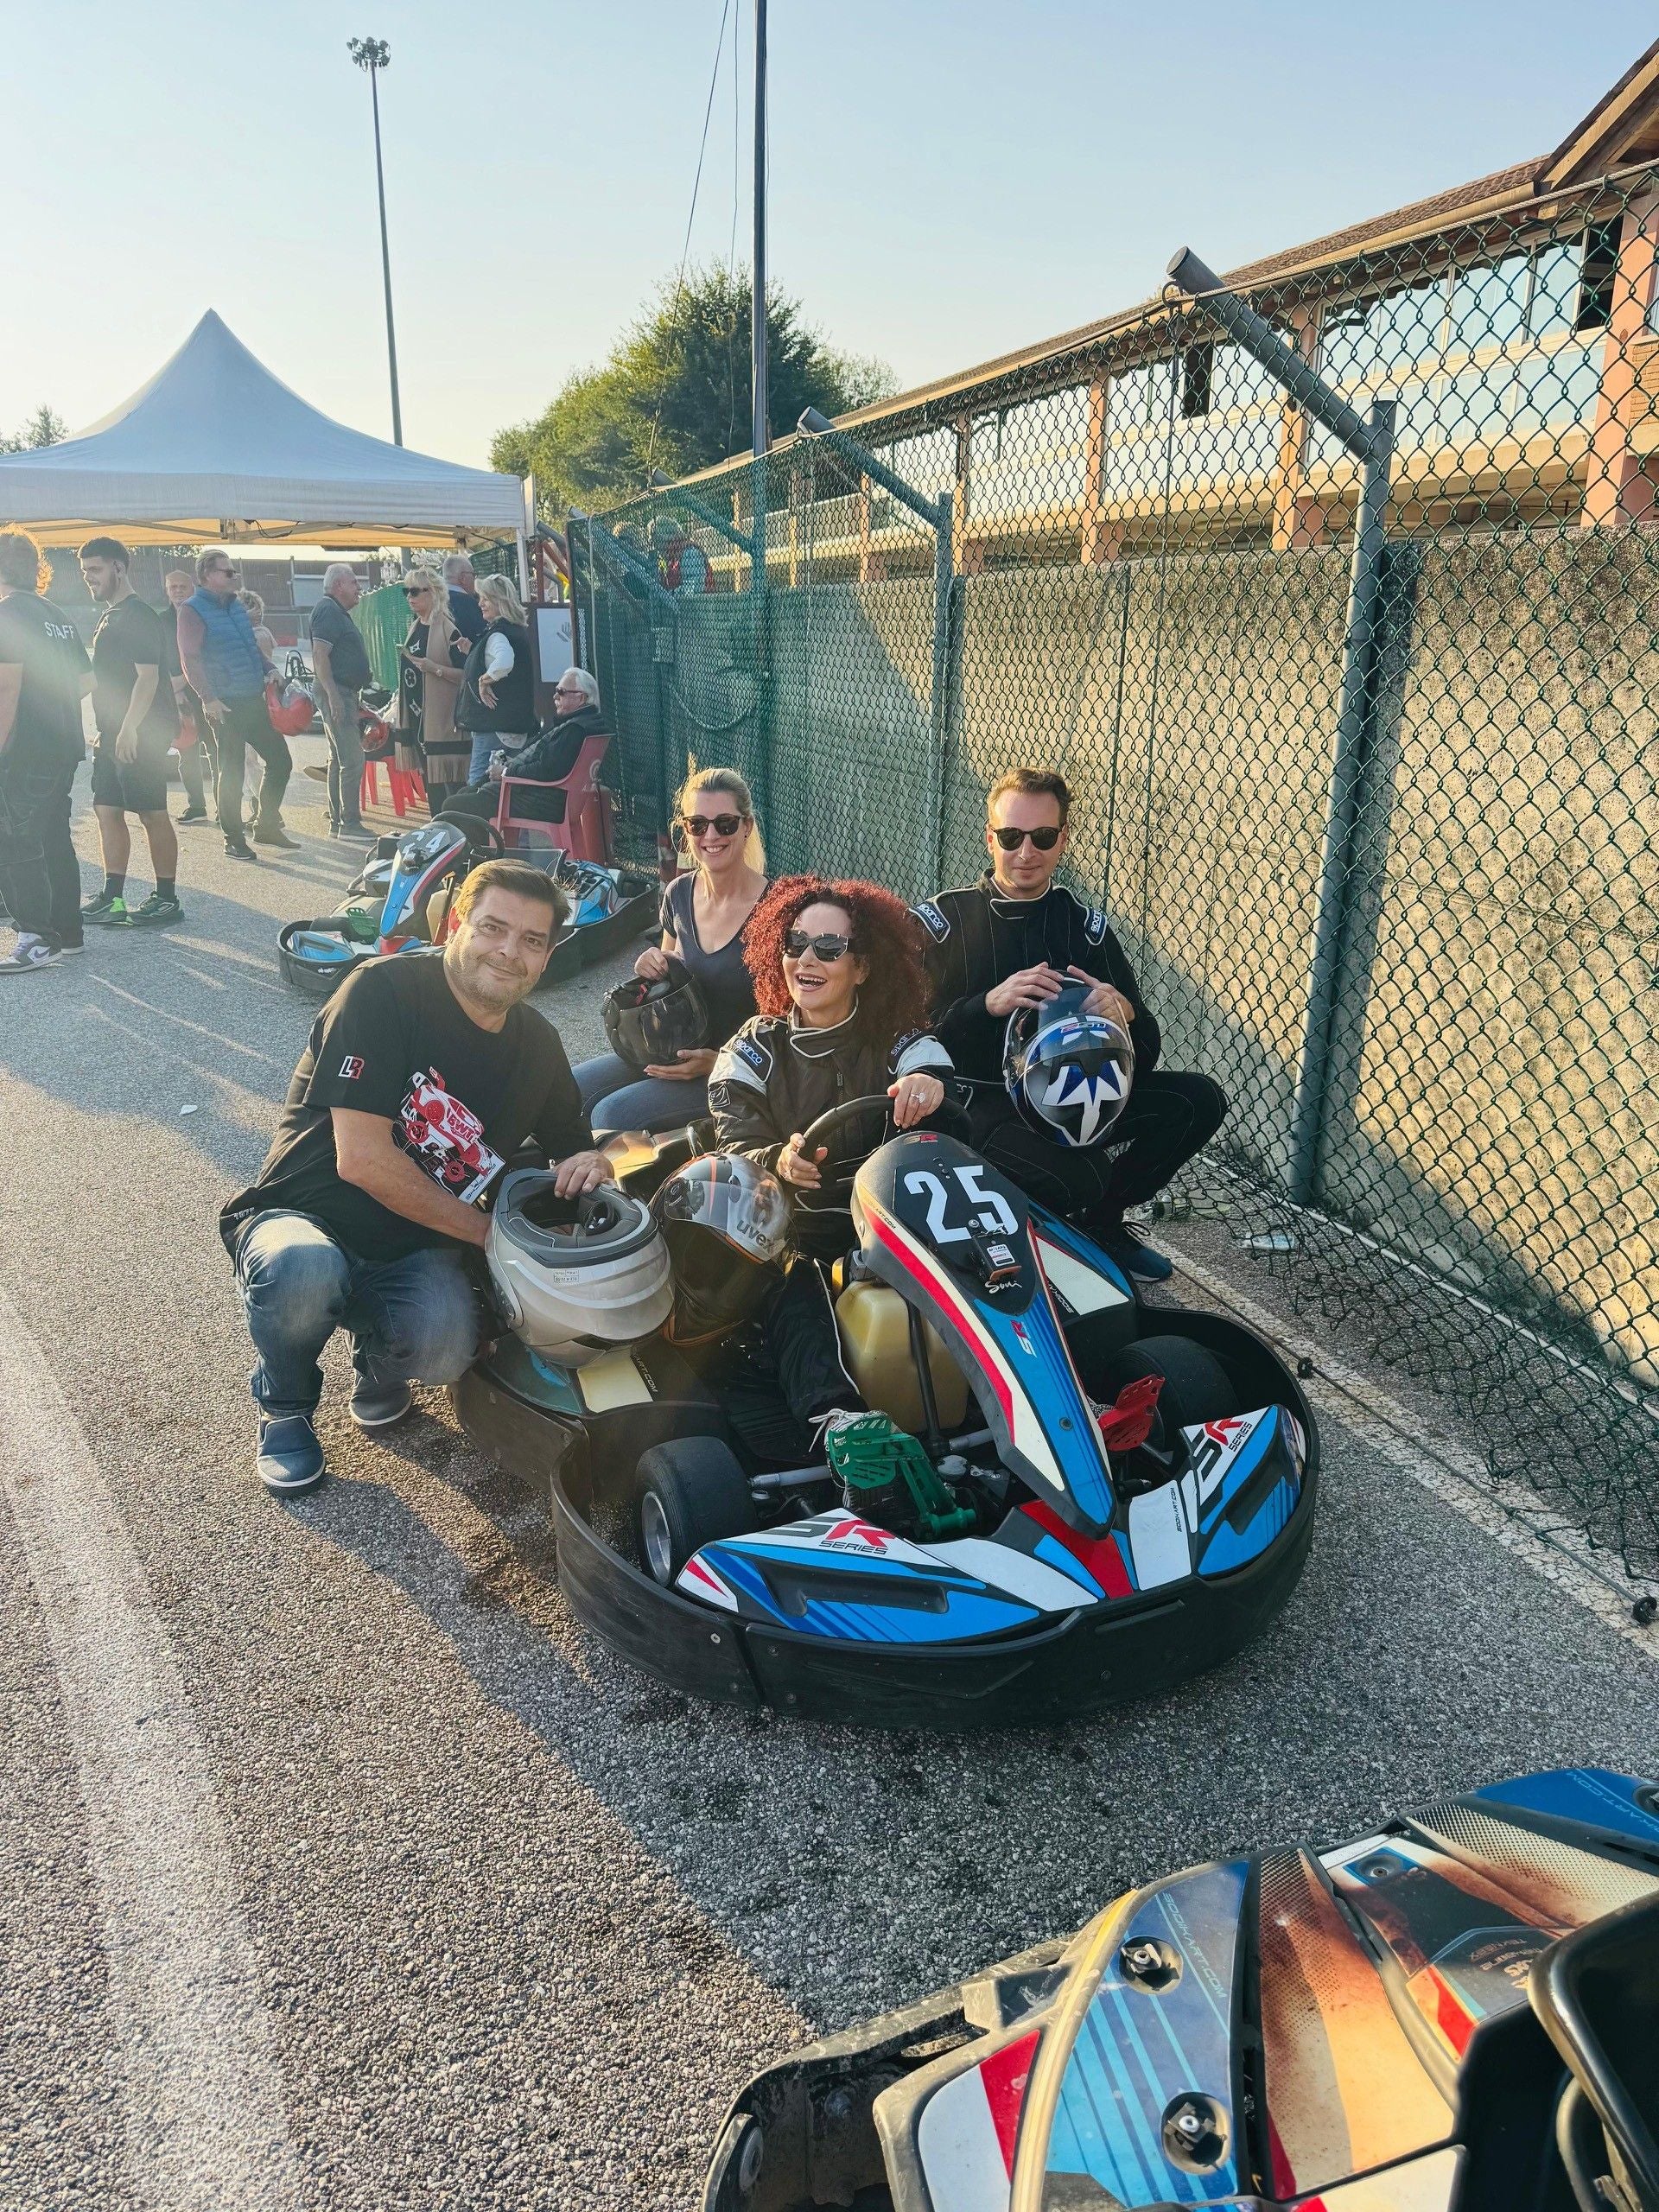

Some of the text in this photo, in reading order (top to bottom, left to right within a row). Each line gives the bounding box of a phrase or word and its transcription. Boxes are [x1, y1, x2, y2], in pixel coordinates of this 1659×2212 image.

[44, 621, 74, 639] STAFF
[402, 830, 446, 855] 24
[917, 903, 944, 928] sparco
[734, 1039, 763, 1065] sparco
[903, 1165, 1019, 1244] 25
[736, 1220, 775, 1251] uvex
[1228, 1421, 1253, 1452] SERIES
[818, 1540, 888, 1555] SERIES
